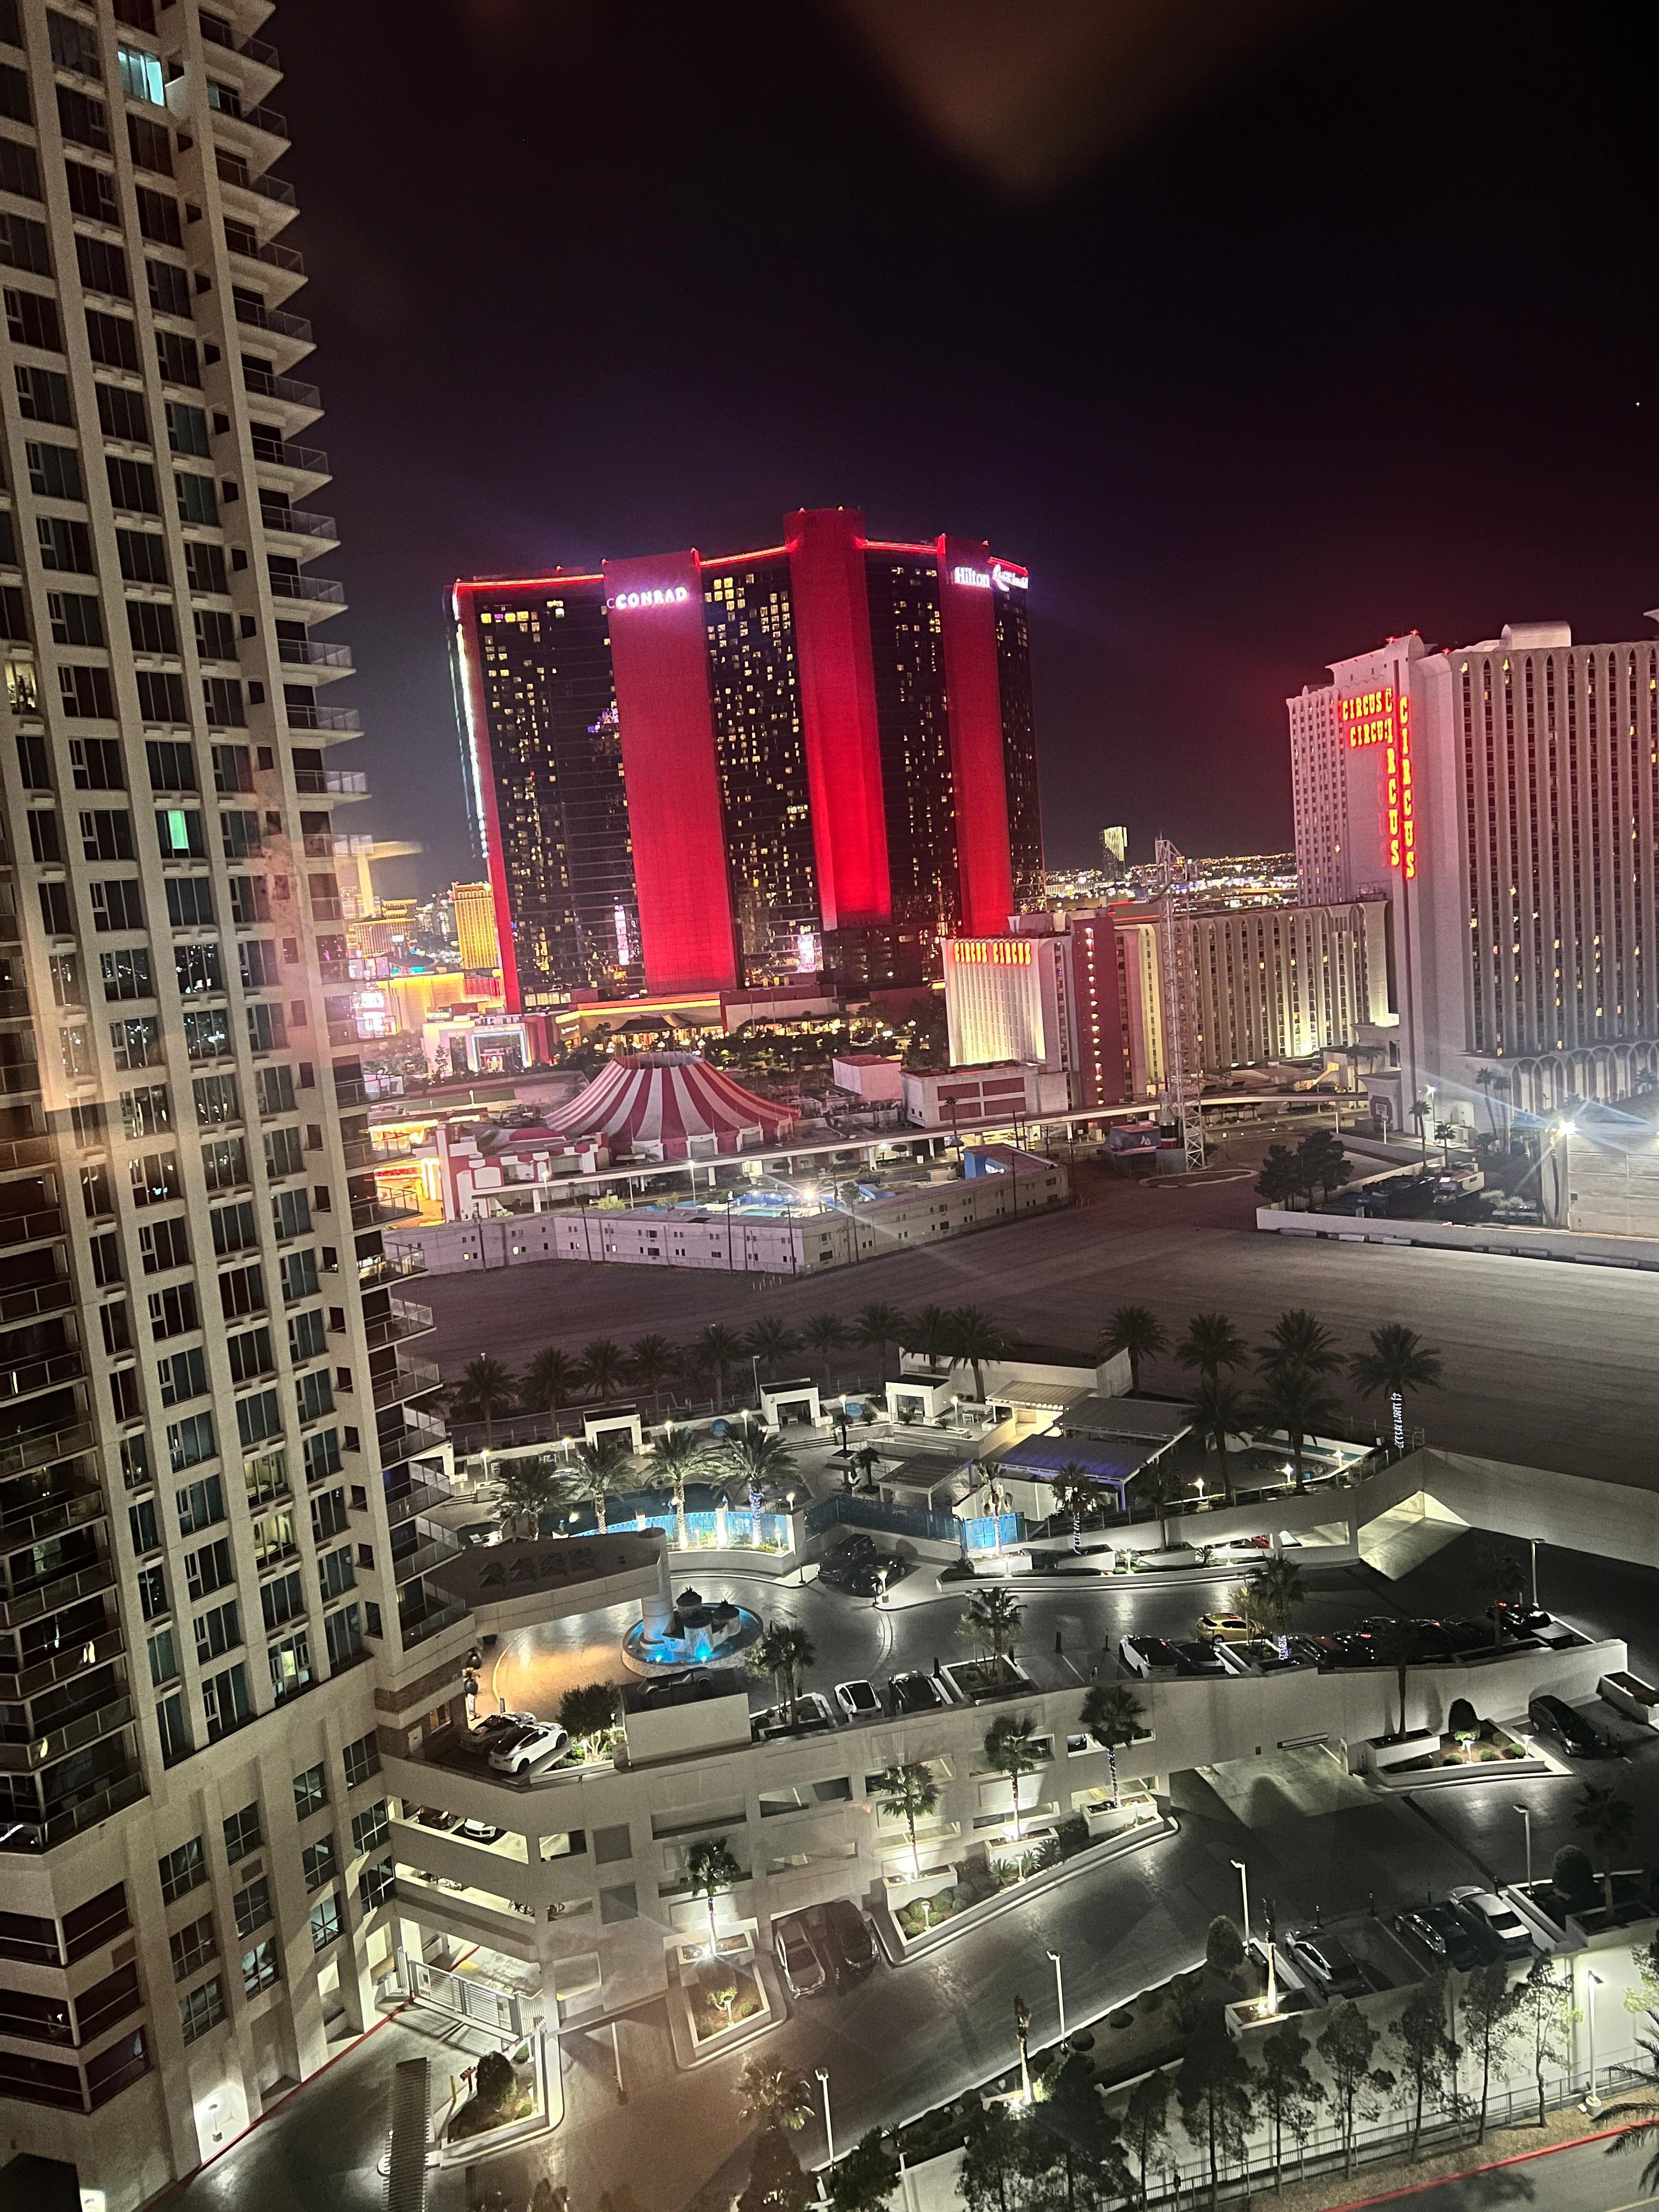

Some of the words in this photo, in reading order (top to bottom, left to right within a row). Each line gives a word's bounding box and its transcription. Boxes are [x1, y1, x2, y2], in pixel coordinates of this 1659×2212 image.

[954, 567, 991, 589] Hilton
[615, 586, 689, 611] CONRAD
[1342, 691, 1383, 721] CIRCUS
[1385, 686, 1400, 865] CIRCUS
[1398, 696, 1415, 878] CIRCUS
